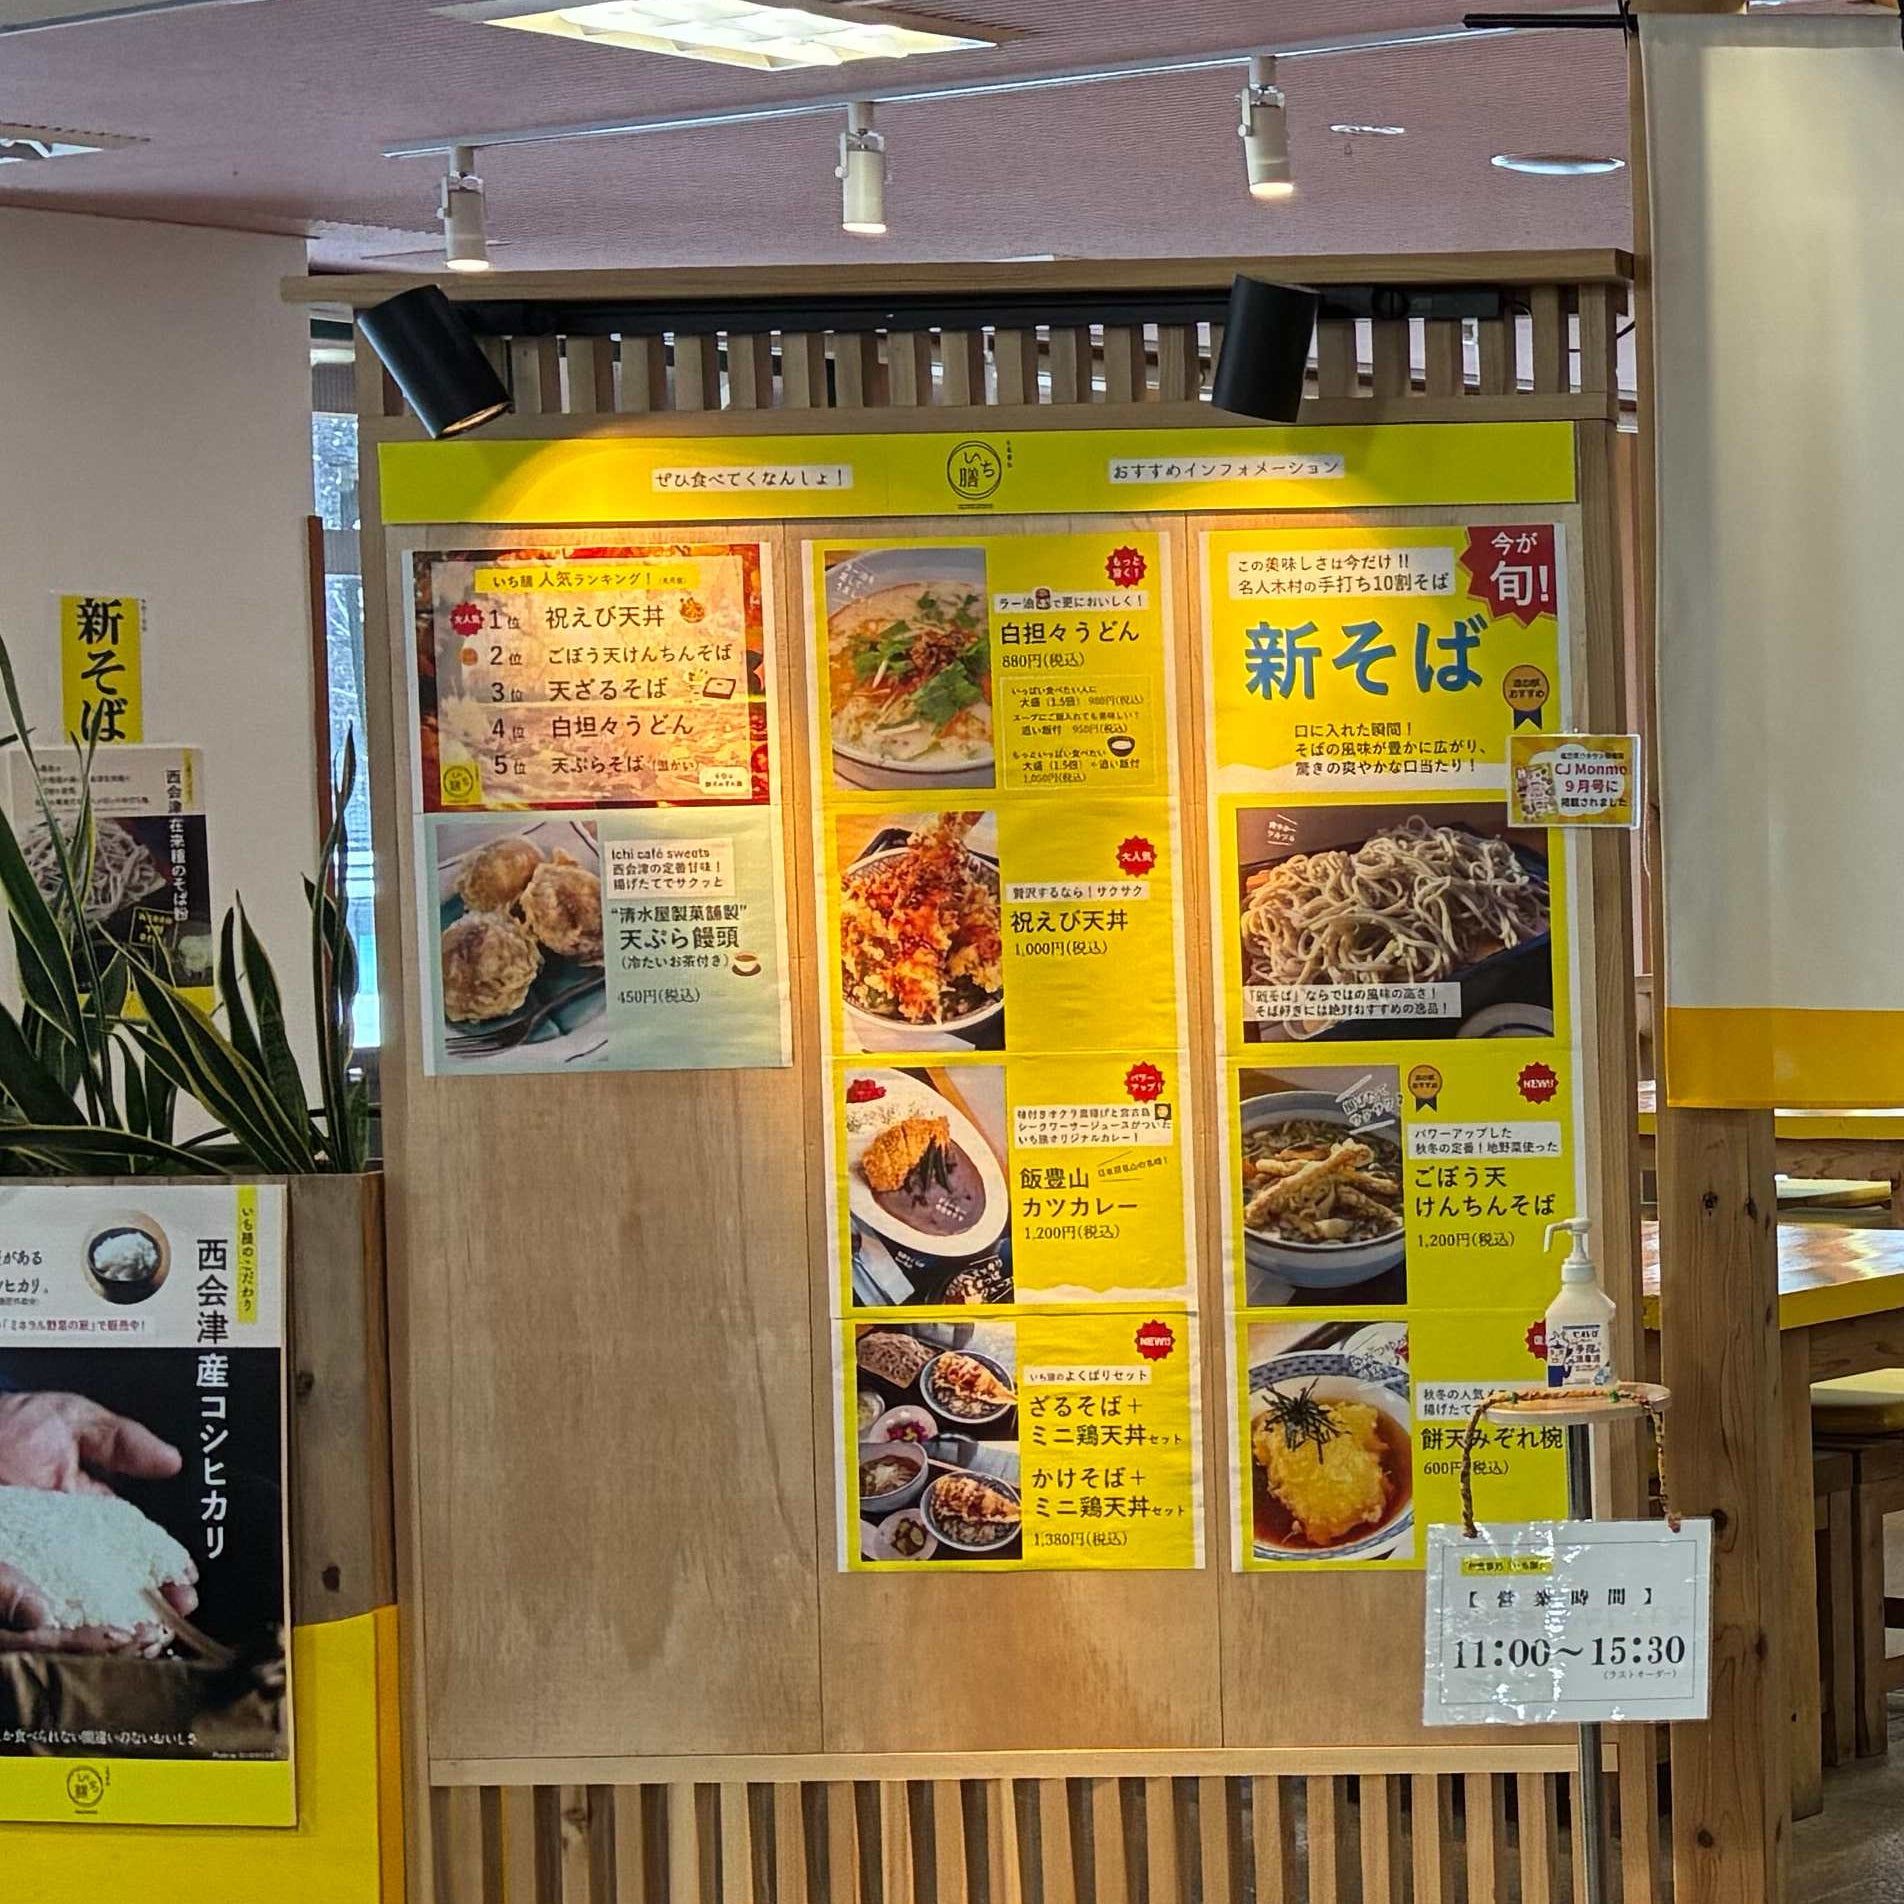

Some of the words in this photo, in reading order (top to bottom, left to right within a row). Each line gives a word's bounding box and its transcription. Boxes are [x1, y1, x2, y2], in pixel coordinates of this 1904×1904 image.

[654, 468, 846, 489] ぜひ食べてくなんしょ！
[1113, 458, 1341, 480] おすすめインフォメーション
[1490, 531, 1538, 556] 今が
[1237, 572, 1449, 595] 名人木村の手打ち10割そば
[1489, 563, 1550, 606] 旬！
[489, 608, 521, 630] 1位
[545, 604, 665, 629] 祝えび天丼
[489, 645, 522, 666] 2位
[547, 643, 732, 664] ごぼう天けんちんそば
[1002, 652, 1085, 668] 880円(税込)
[1245, 612, 1489, 700] 新そば
[77, 597, 128, 743] 新そば
[491, 681, 524, 703] 3位
[548, 677, 668, 701] 天ざるそば
[492, 718, 526, 739] 4位
[1294, 722, 1412, 738] 口に入れた瞬間！
[1295, 740, 1487, 756] そばの風味が豊かに広がり、
[494, 754, 527, 775] 5位
[552, 754, 645, 774] 天ぷらそば
[1295, 758, 1476, 777] 驚きの爽やかな口当たり！
[1555, 762, 1572, 776] CJ
[1564, 779, 1619, 794] 9月号に
[1010, 908, 1129, 934] 祝えび天丼
[620, 925, 739, 951] 天ぷら饅頭
[1015, 940, 1108, 957] 1,000円(税込)
[1414, 1127, 1512, 1140] パワーアップした
[1020, 1167, 1089, 1190] 飯豊山
[1414, 1165, 1507, 1189] ごぼう天
[1022, 1196, 1138, 1218] カツカレー
[1415, 1193, 1556, 1217] けんちんそば
[1024, 1224, 1121, 1241] 1,200円(税込)
[1417, 1232, 1516, 1249] 1,200円(税込)
[0, 1250, 43, 1266] がある
[196, 1238, 229, 1559] 西会津産コシヒカリ
[1031, 1423, 1183, 1447] ミニ鶏天丼セット
[1035, 1496, 1186, 1519] ミニ鶏天丼セット
[1033, 1530, 1129, 1547] 1,380円(税込)
